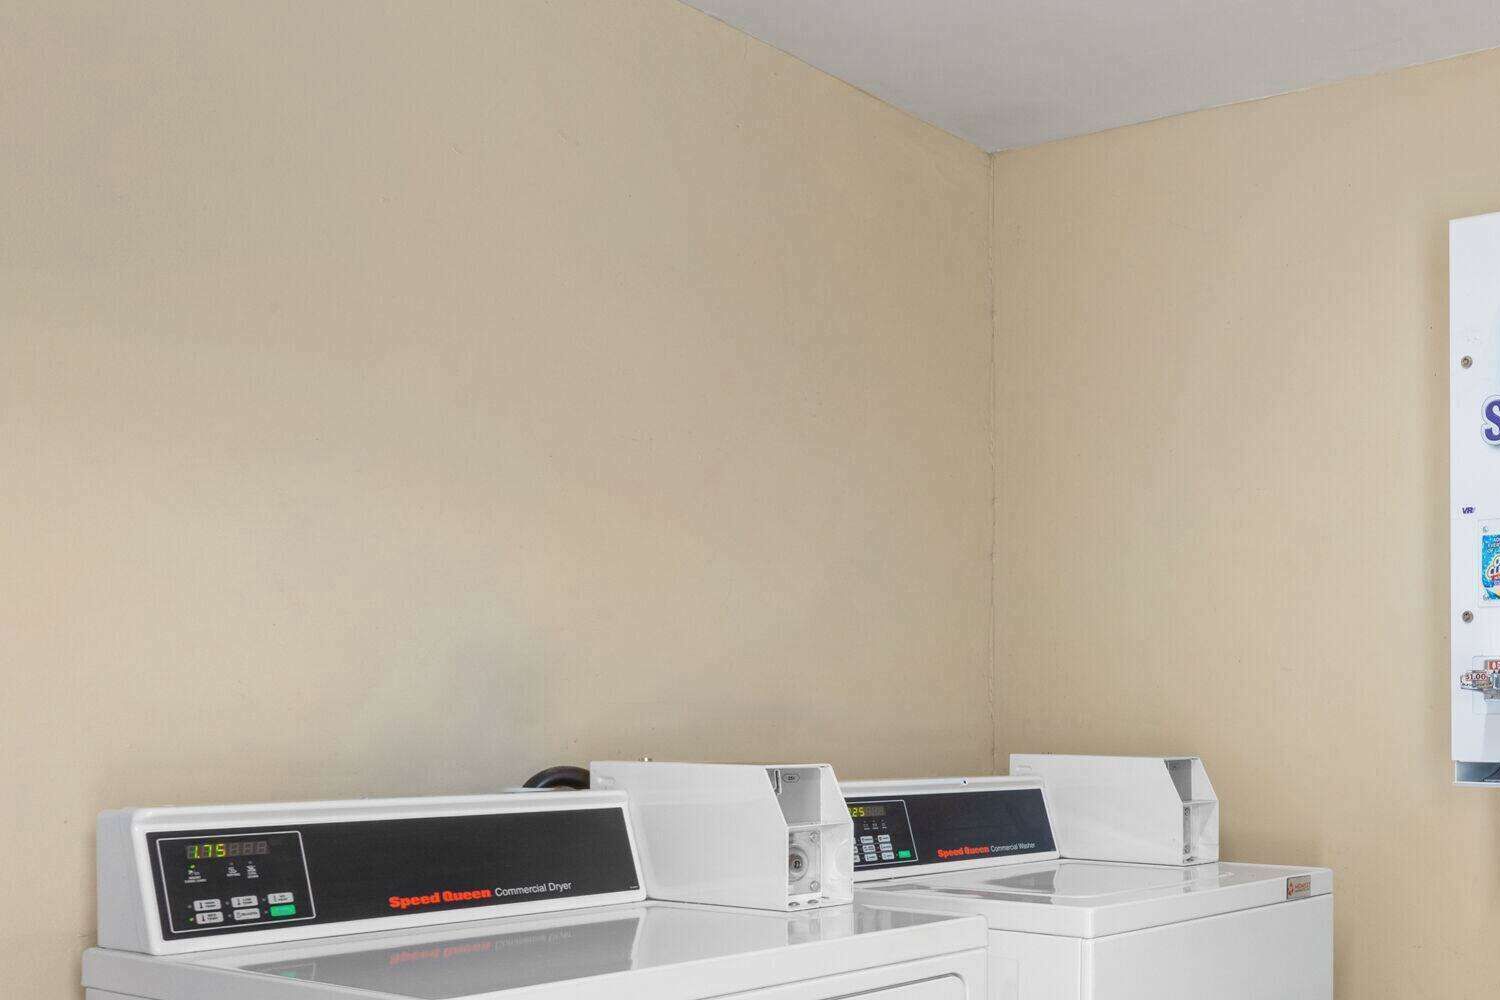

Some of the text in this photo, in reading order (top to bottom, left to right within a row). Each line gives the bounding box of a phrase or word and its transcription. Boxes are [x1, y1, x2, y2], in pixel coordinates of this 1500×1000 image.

[937, 847, 964, 859] Speed
[964, 845, 990, 855] Queen
[990, 844, 1018, 853] Commercial
[389, 881, 572, 910] Speed Queen Commercial Dryer
